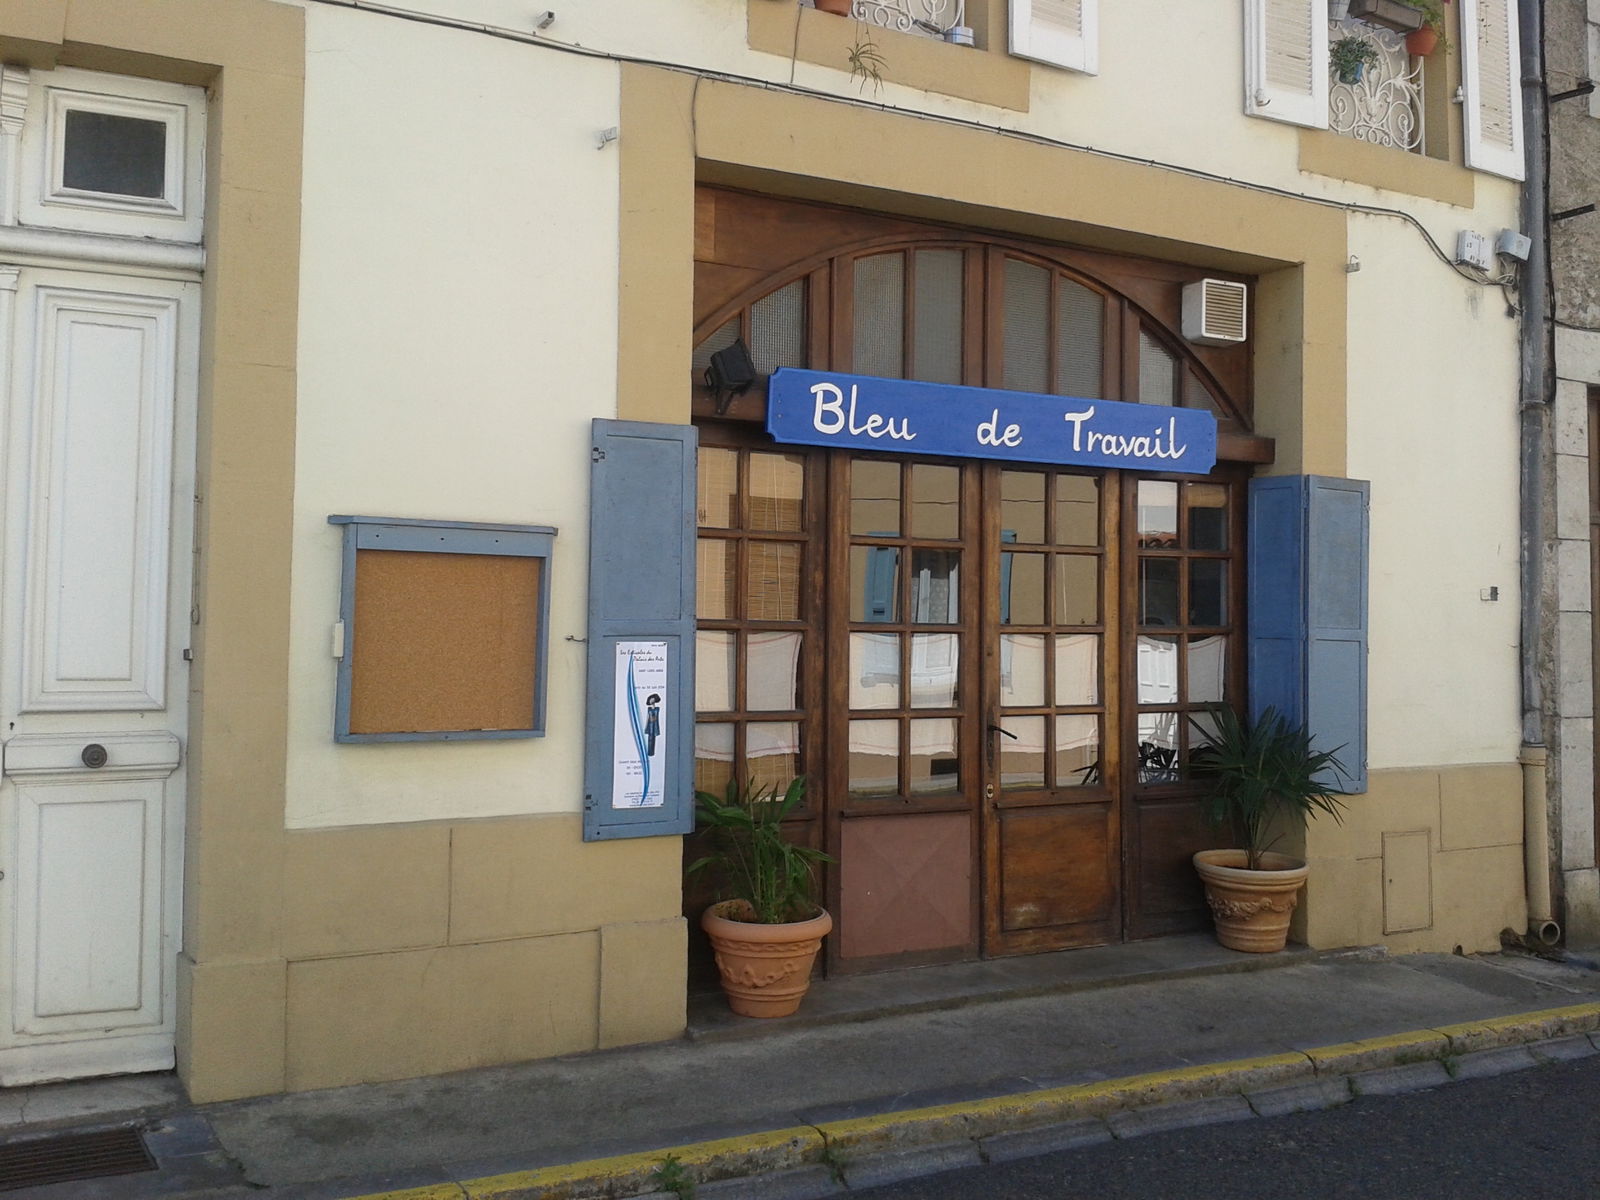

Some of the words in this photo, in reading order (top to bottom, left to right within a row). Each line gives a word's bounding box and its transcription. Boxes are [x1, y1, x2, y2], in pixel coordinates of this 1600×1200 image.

[810, 382, 917, 441] Bleu
[976, 408, 1023, 447] de
[1065, 405, 1187, 460] Travail
